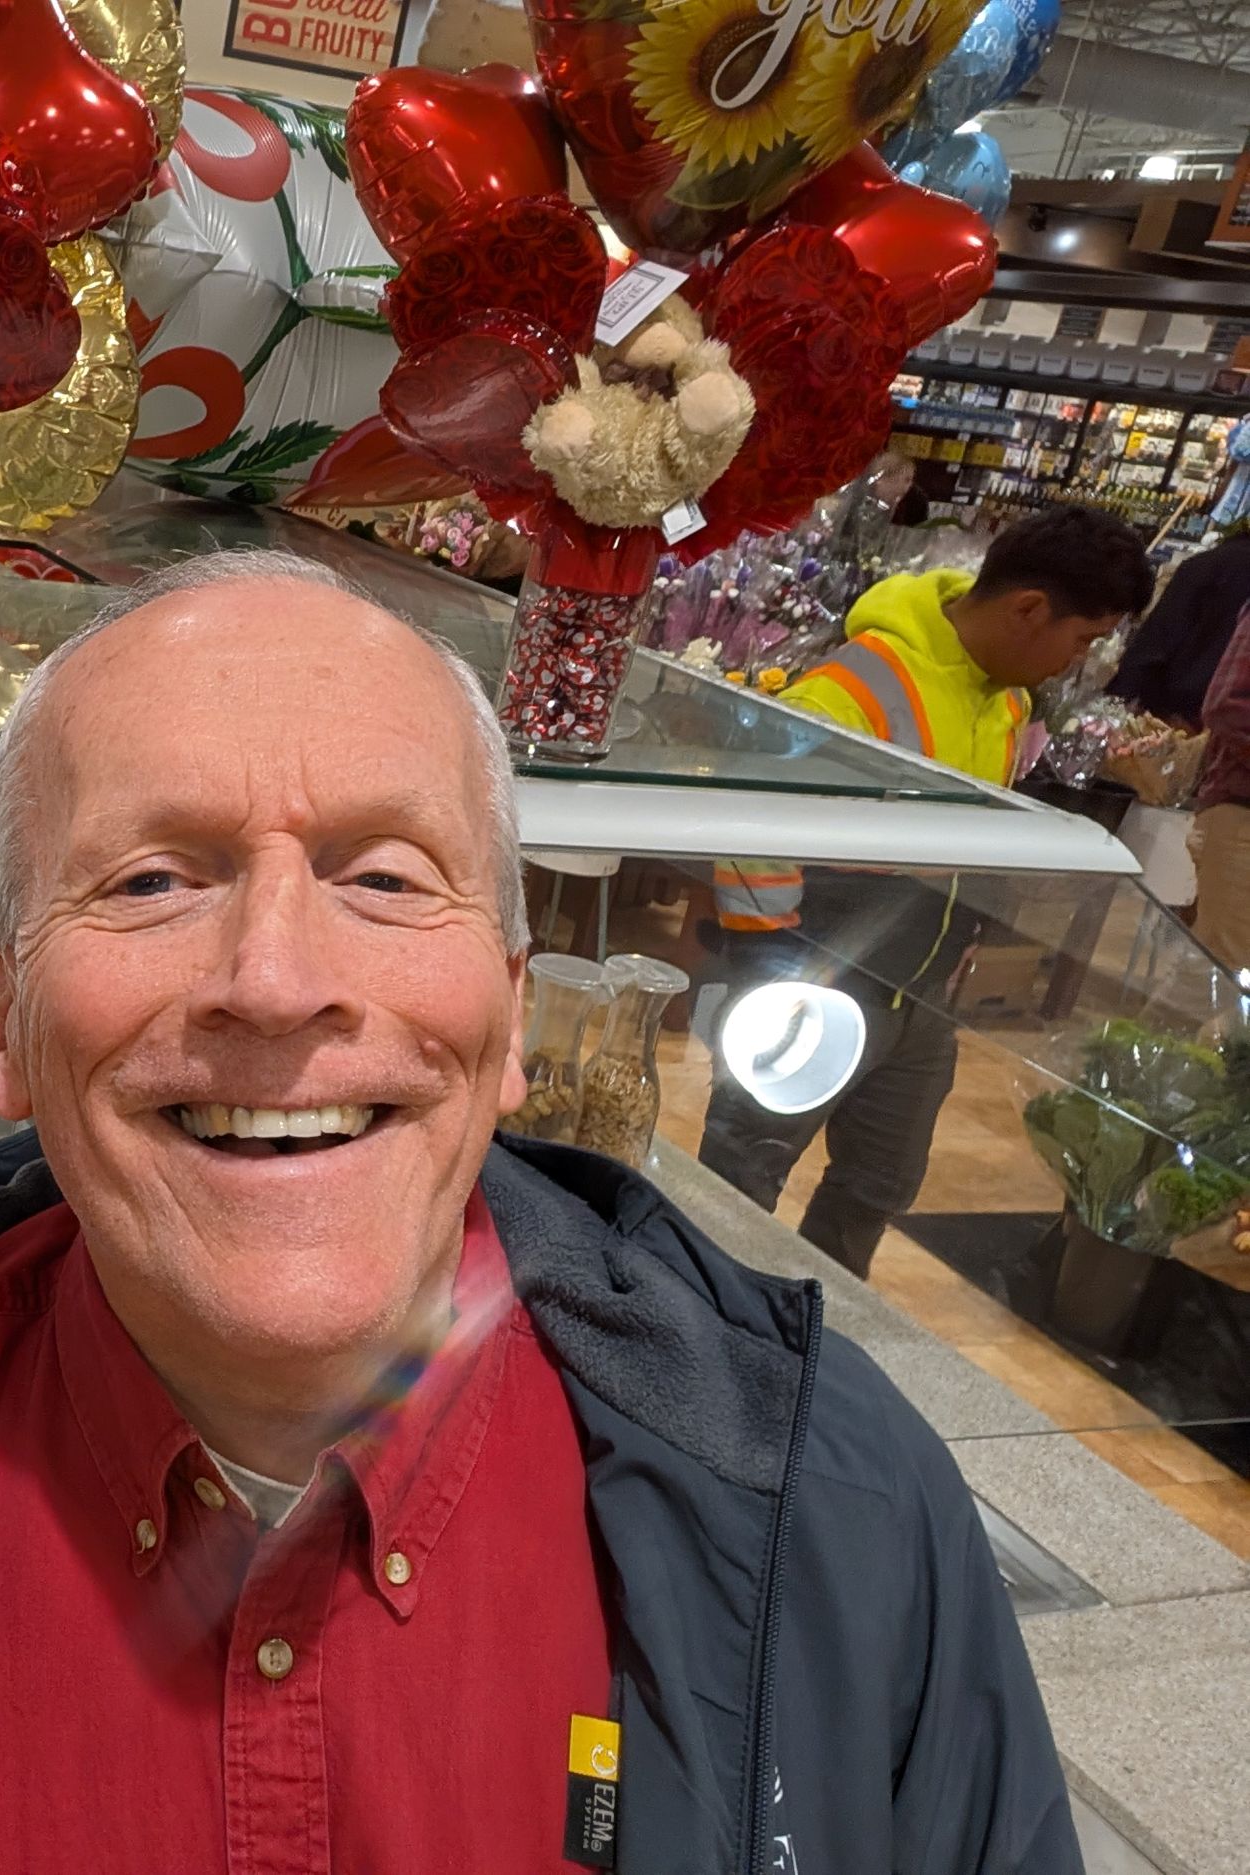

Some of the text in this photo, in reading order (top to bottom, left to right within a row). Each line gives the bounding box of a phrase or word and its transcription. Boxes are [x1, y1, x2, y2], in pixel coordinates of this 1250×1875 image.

[298, 16, 385, 62] FRUITY
[710, 0, 942, 109] you
[582, 1797, 592, 1849] SYSTEM
